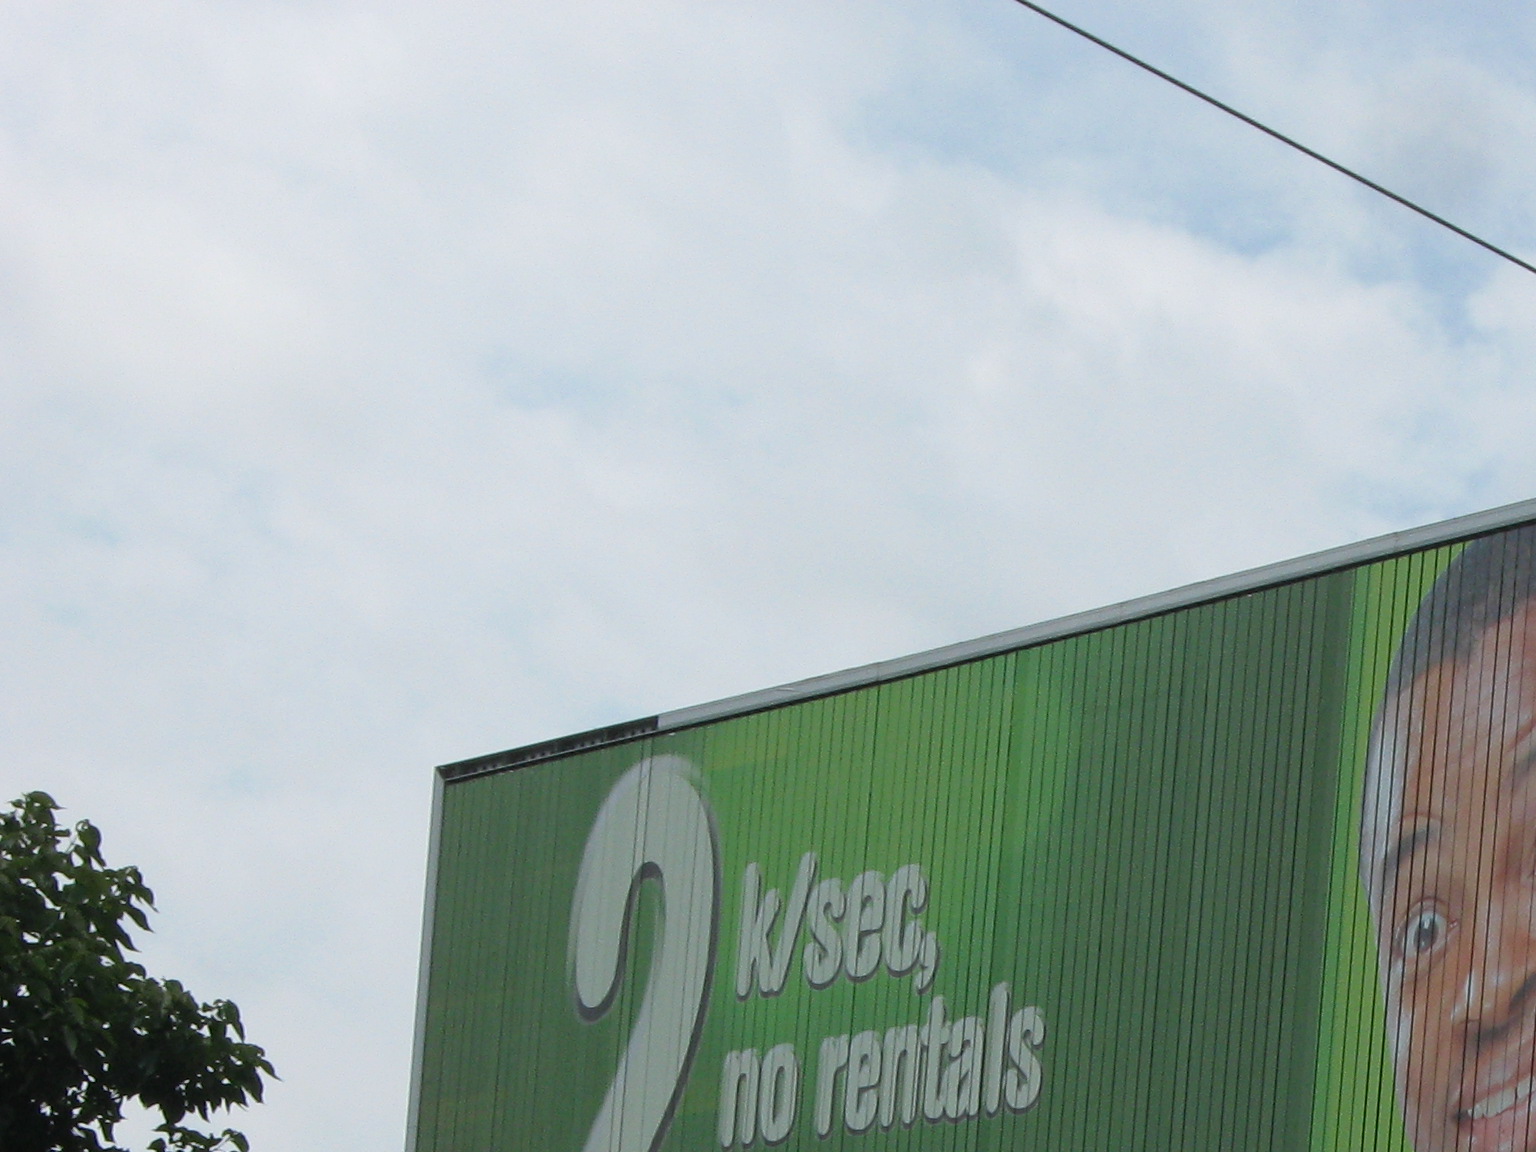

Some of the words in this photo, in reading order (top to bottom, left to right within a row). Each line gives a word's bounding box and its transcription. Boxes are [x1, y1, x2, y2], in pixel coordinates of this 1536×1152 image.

[736, 851, 940, 1001] k/sec,
[717, 1042, 800, 1150] no
[815, 980, 1047, 1140] rentals
